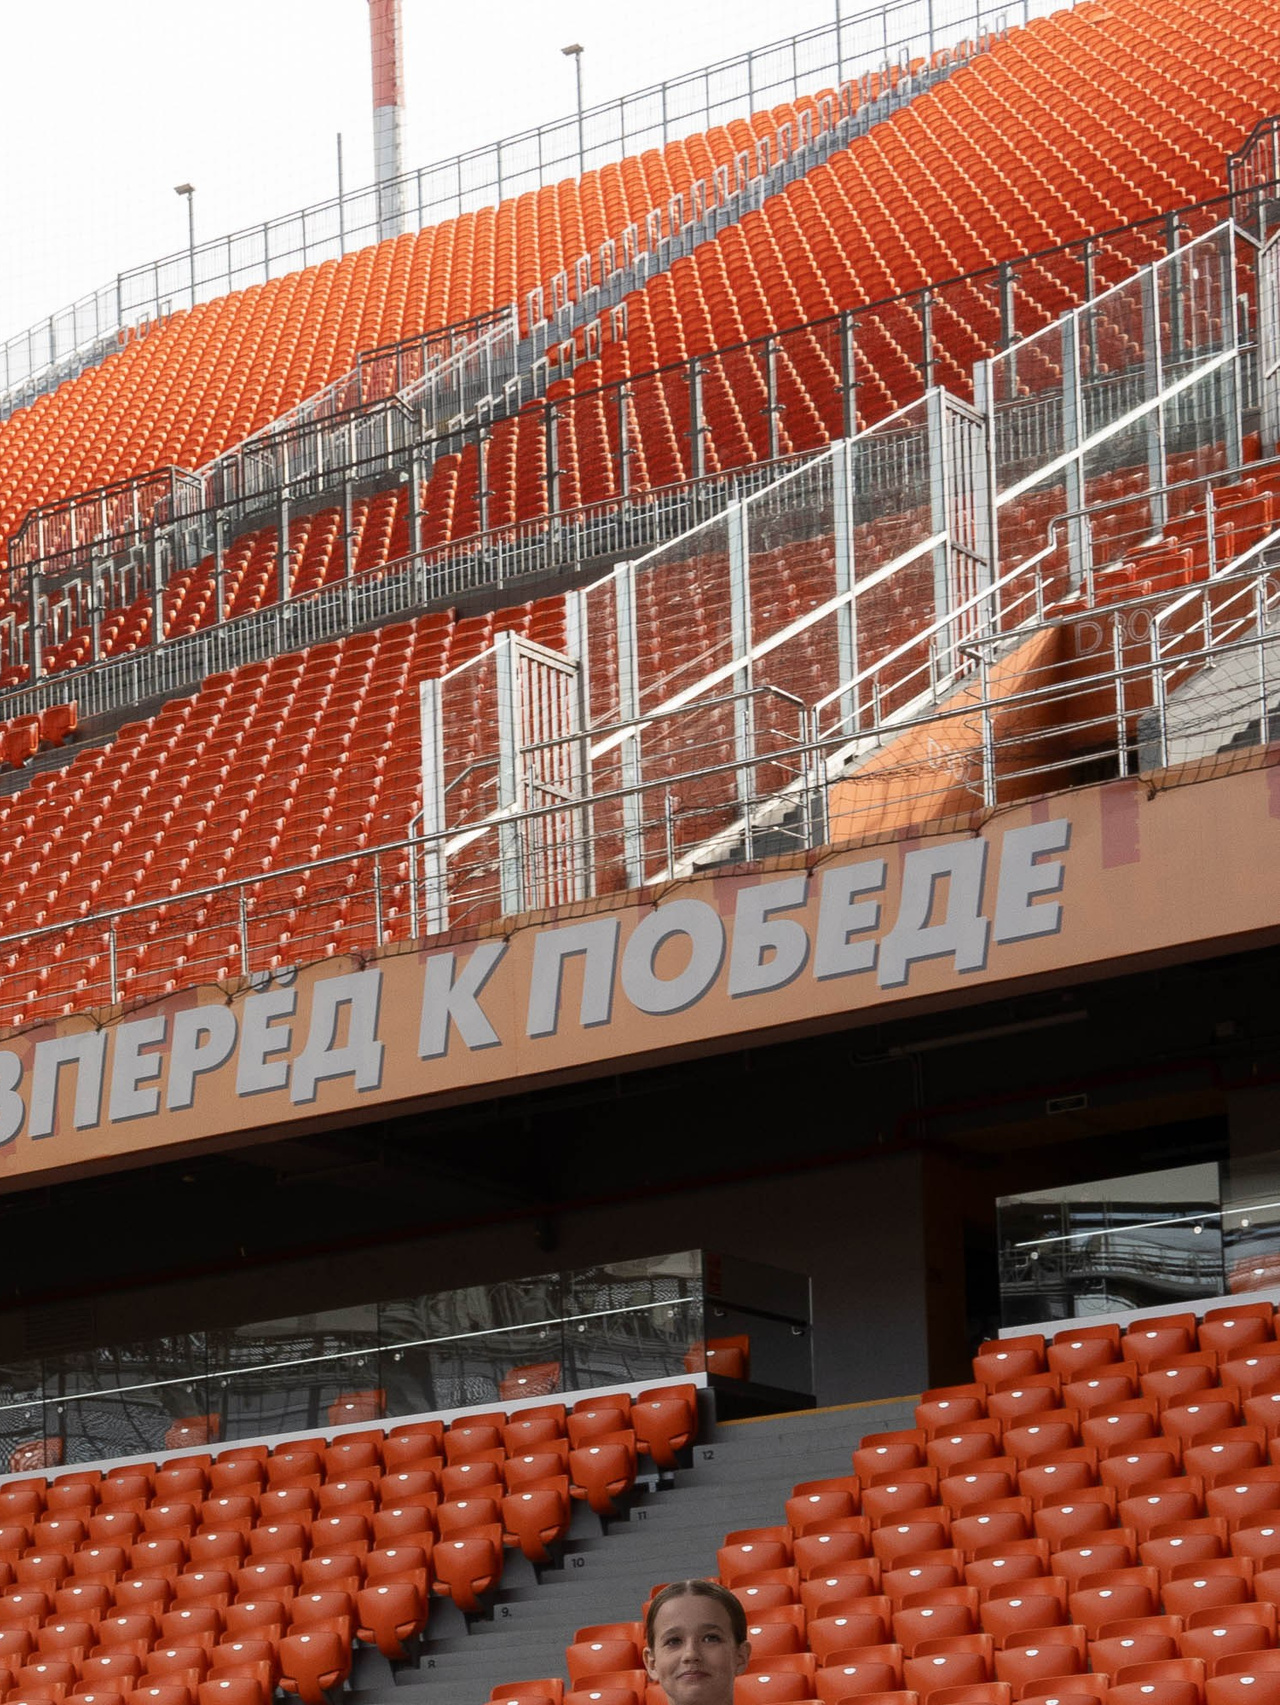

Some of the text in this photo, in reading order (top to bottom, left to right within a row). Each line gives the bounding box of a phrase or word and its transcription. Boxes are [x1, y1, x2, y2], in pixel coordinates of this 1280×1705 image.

[417, 941, 510, 1059] К
[525, 817, 1071, 1039] ПОБЕДЕ
[702, 1450, 714, 1460] 12
[572, 1557, 585, 1568] 10
